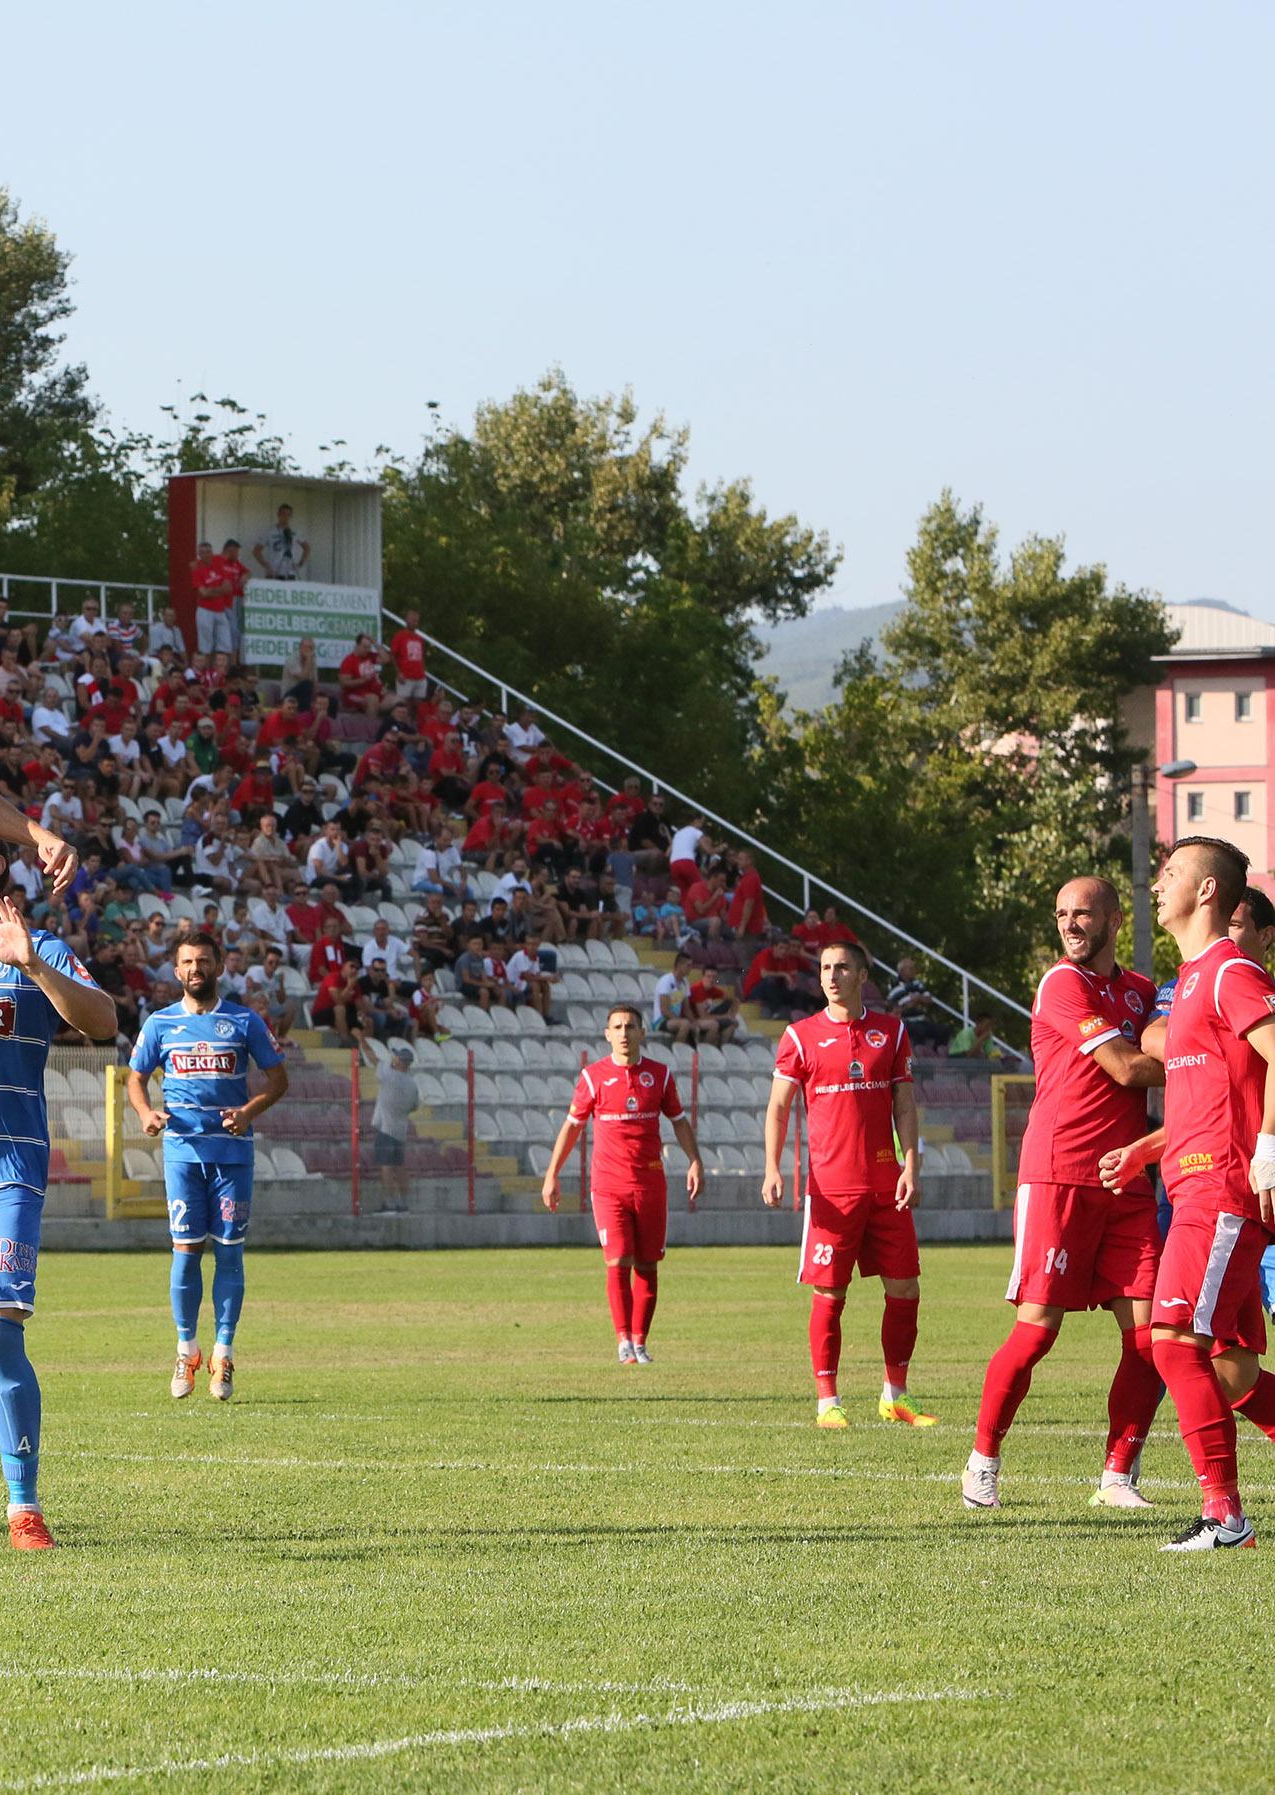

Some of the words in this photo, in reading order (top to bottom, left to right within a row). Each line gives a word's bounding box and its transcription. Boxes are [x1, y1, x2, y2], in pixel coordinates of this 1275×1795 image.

[244, 586, 375, 610] HEIDELBERGCEMENT
[244, 611, 375, 635] HEIDELBERGCEMENT
[175, 1056, 231, 1071] NEKTAR
[1179, 1153, 1213, 1168] MGM
[812, 1243, 834, 1266] 23
[1044, 1247, 1068, 1275] 14
[17, 1435, 32, 1454] 4
